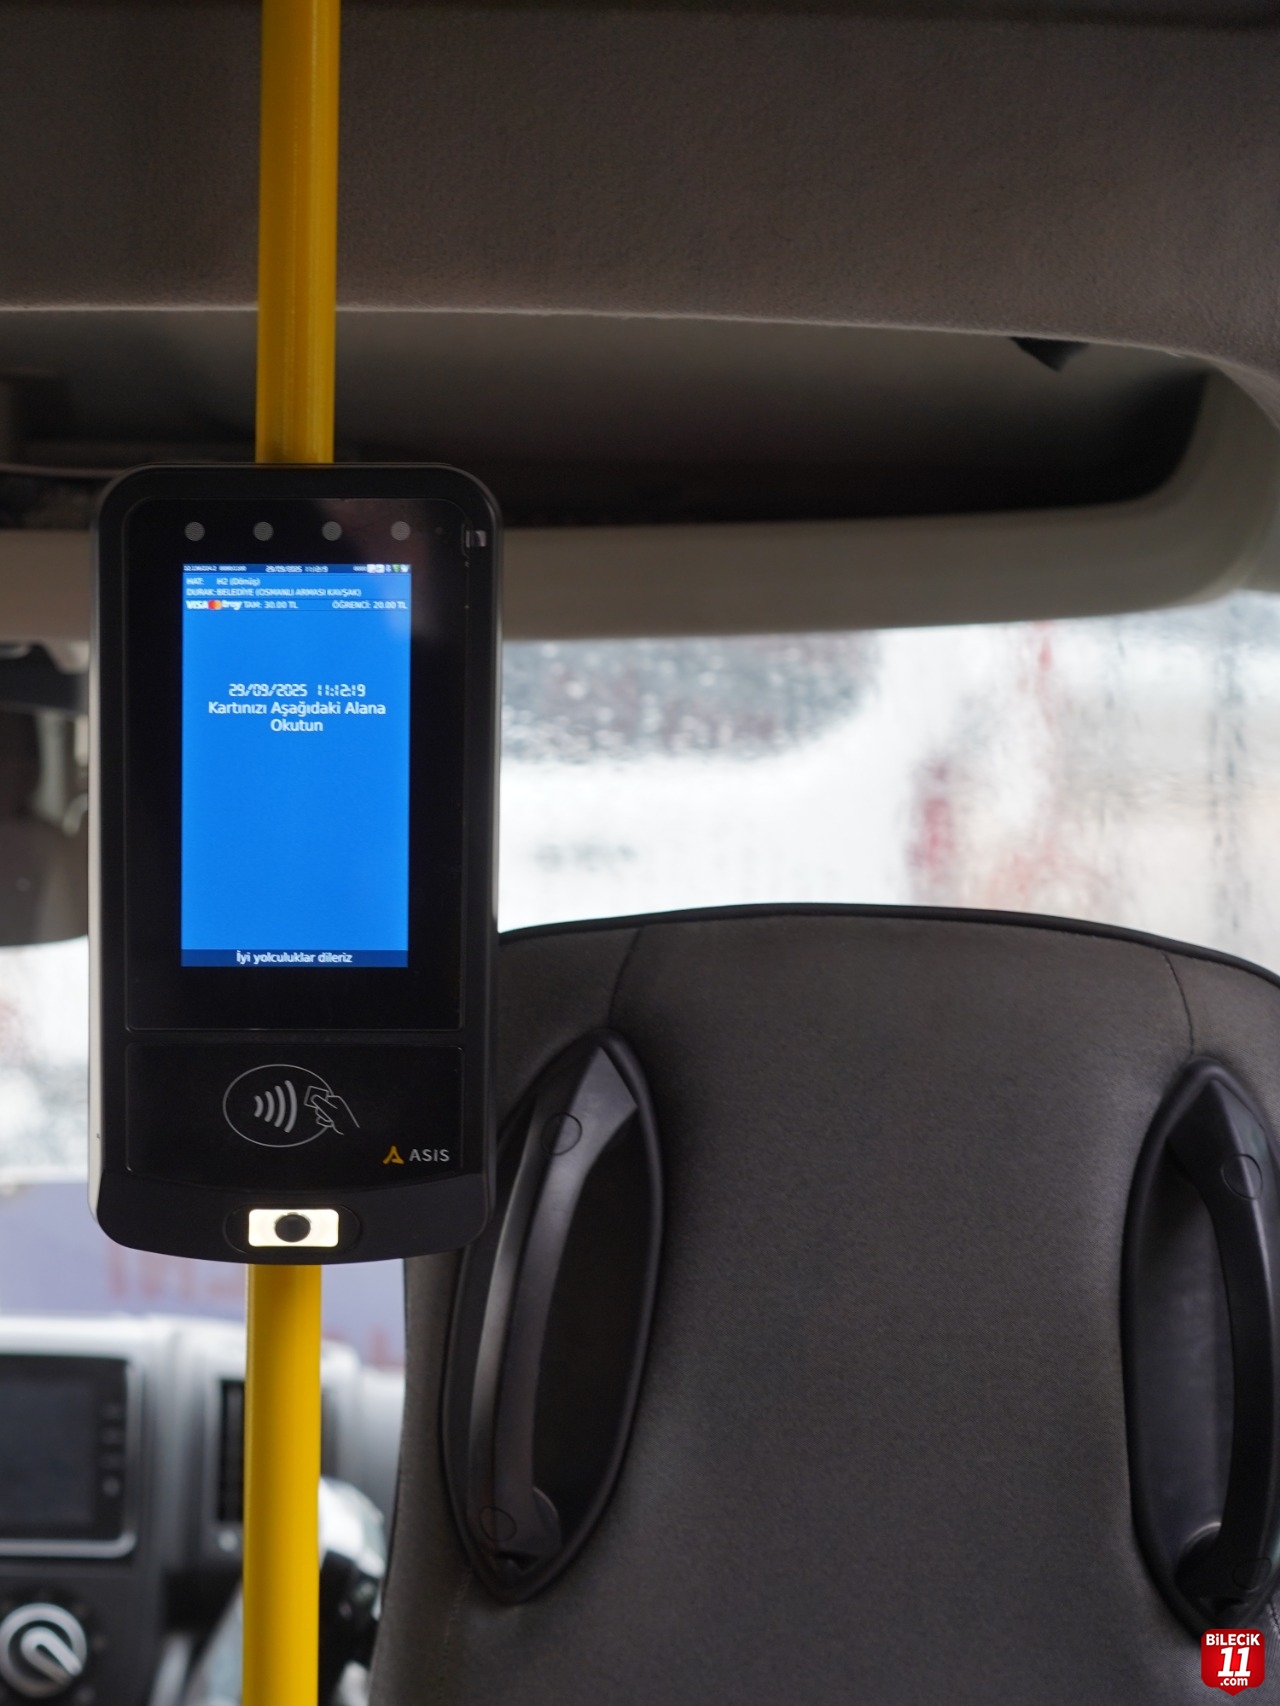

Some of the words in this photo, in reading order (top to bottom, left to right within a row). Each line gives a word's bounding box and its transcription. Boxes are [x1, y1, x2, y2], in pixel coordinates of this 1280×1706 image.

[185, 600, 209, 609] VISA
[264, 601, 288, 609] 30.00
[288, 601, 299, 609] TL
[373, 601, 397, 609] 20.00
[397, 601, 408, 609] TL
[228, 683, 308, 697] 29/09/2025
[317, 683, 366, 697] 11:12:19
[208, 701, 267, 714] Kartınızı
[270, 701, 341, 717] Aşağıdaki
[344, 701, 386, 714] Alana
[270, 719, 323, 732] Okutun
[236, 950, 251, 965] İyi
[253, 952, 315, 965] yolculuklar
[317, 952, 353, 963] dileriz
[408, 1148, 450, 1162] ASIS
